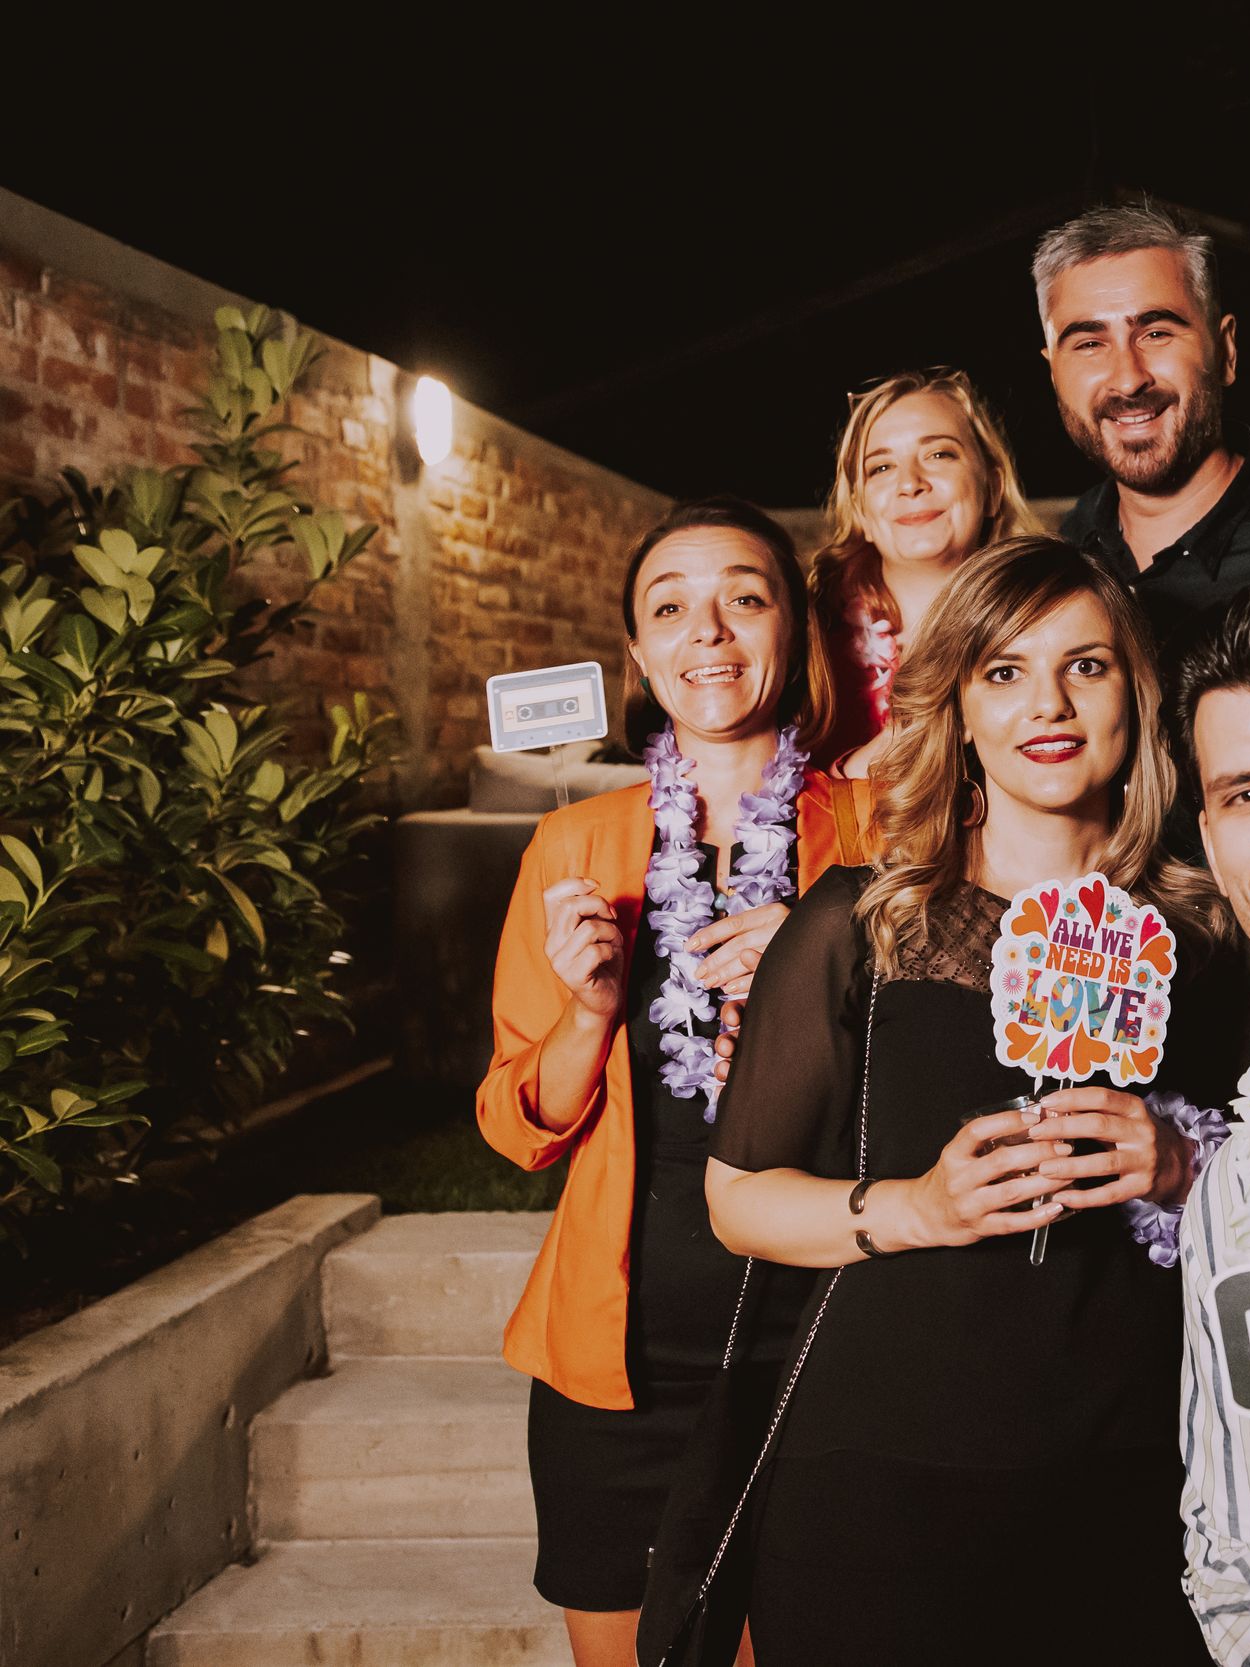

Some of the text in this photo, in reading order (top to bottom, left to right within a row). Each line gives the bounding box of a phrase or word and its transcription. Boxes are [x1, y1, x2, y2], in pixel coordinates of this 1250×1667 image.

[1052, 918, 1133, 959] ALL WE
[1045, 943, 1132, 985] NEED IS
[1018, 968, 1147, 1046] LOVE
